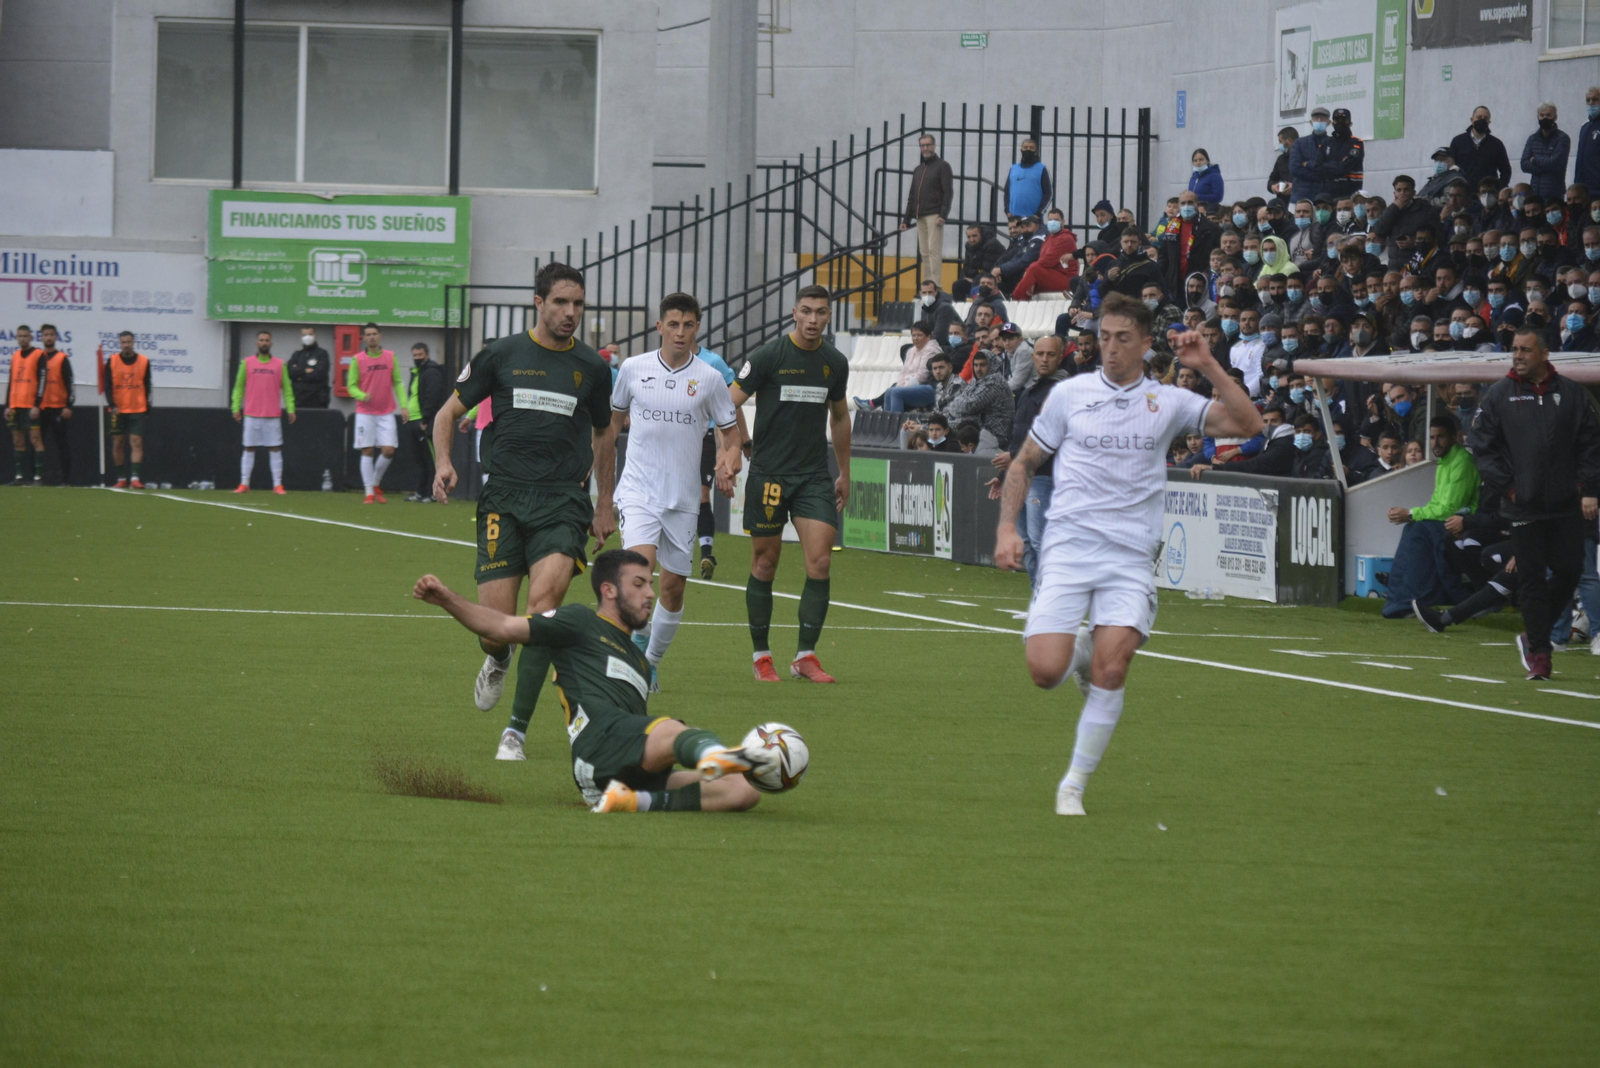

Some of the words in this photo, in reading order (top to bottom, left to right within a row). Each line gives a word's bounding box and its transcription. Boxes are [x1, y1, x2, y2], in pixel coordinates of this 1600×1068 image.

[1354, 38, 1368, 59] CASA
[230, 212, 341, 229] FINANCIAMOS
[347, 215, 376, 230] TUS
[382, 213, 446, 232] SUEÑOS
[101, 340, 157, 350] FOLTOS
[762, 482, 782, 506] 19
[1179, 492, 1185, 515] DE
[487, 513, 500, 540] 6
[1291, 496, 1335, 566] LOCAL
